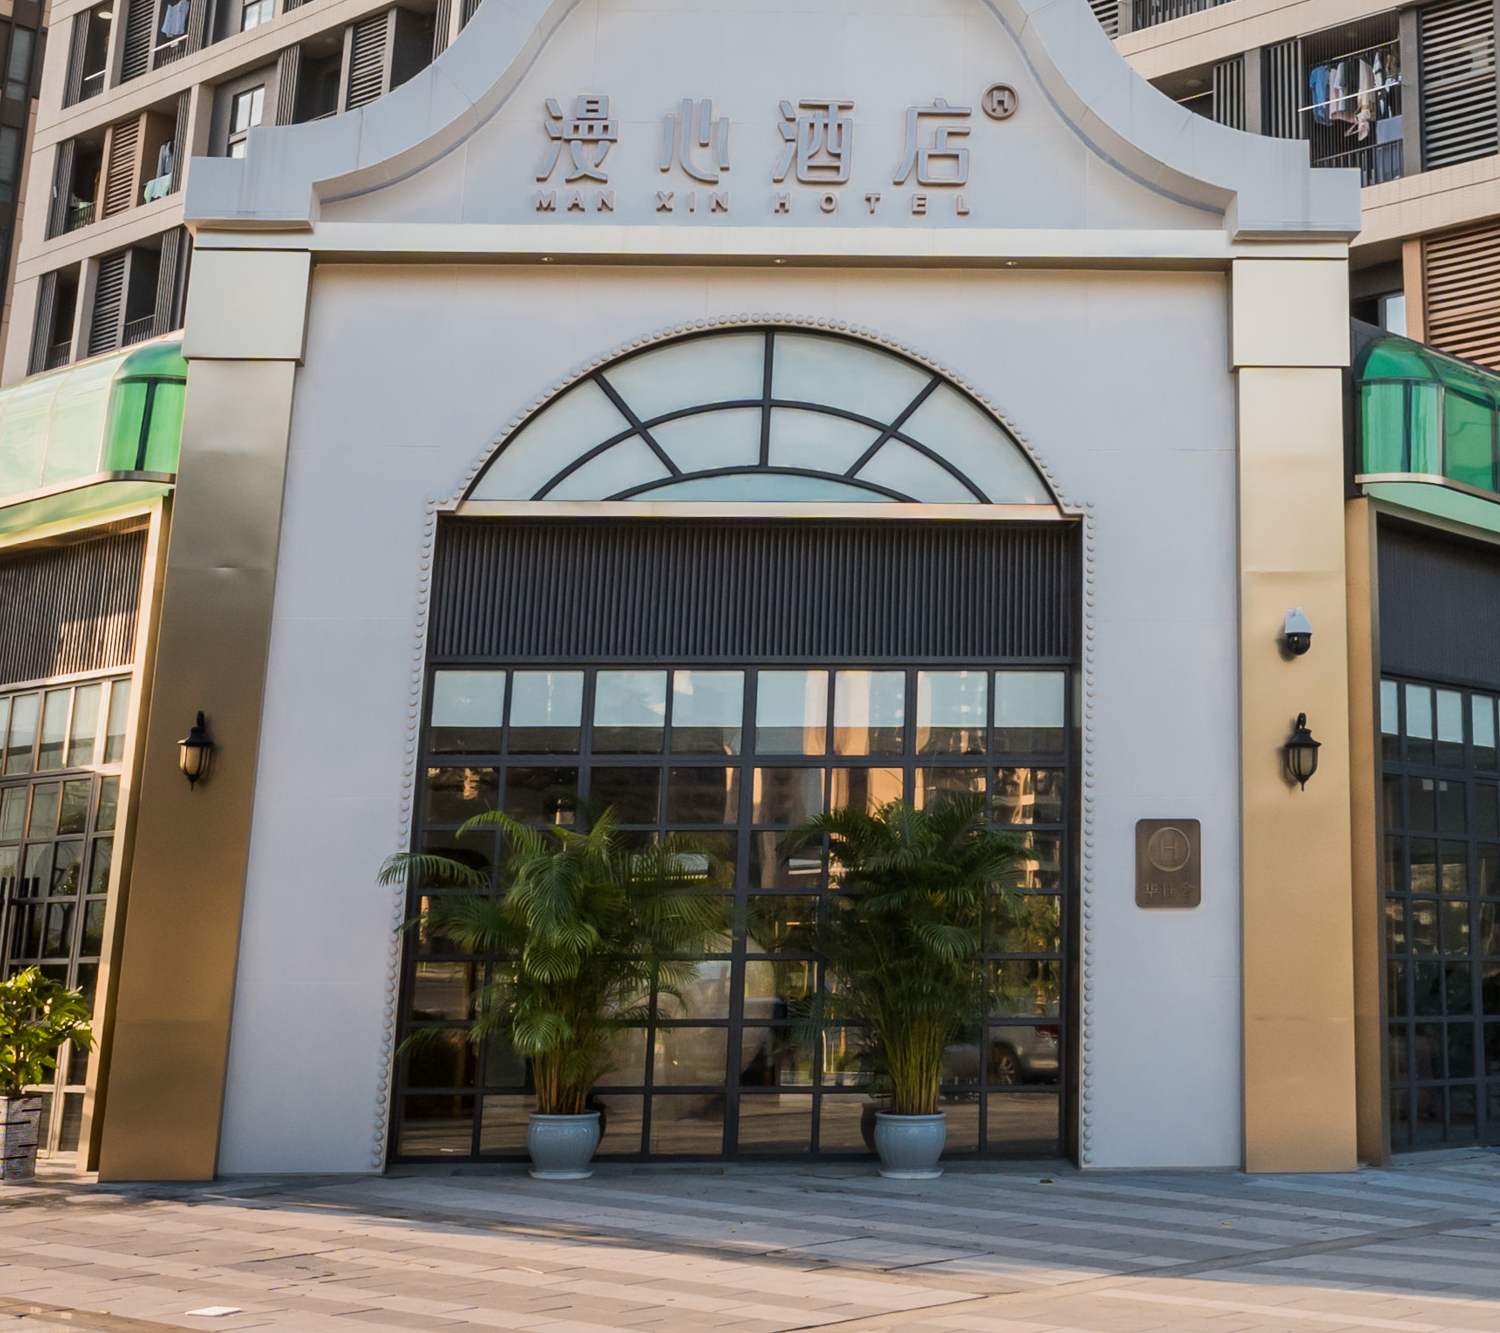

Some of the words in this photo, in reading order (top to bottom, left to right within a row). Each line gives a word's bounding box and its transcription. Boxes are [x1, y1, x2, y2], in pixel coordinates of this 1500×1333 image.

[535, 93, 973, 186] 漫心酒店
[535, 190, 615, 212] MAN
[656, 190, 729, 213] XIN
[773, 192, 971, 215] HOTEL
